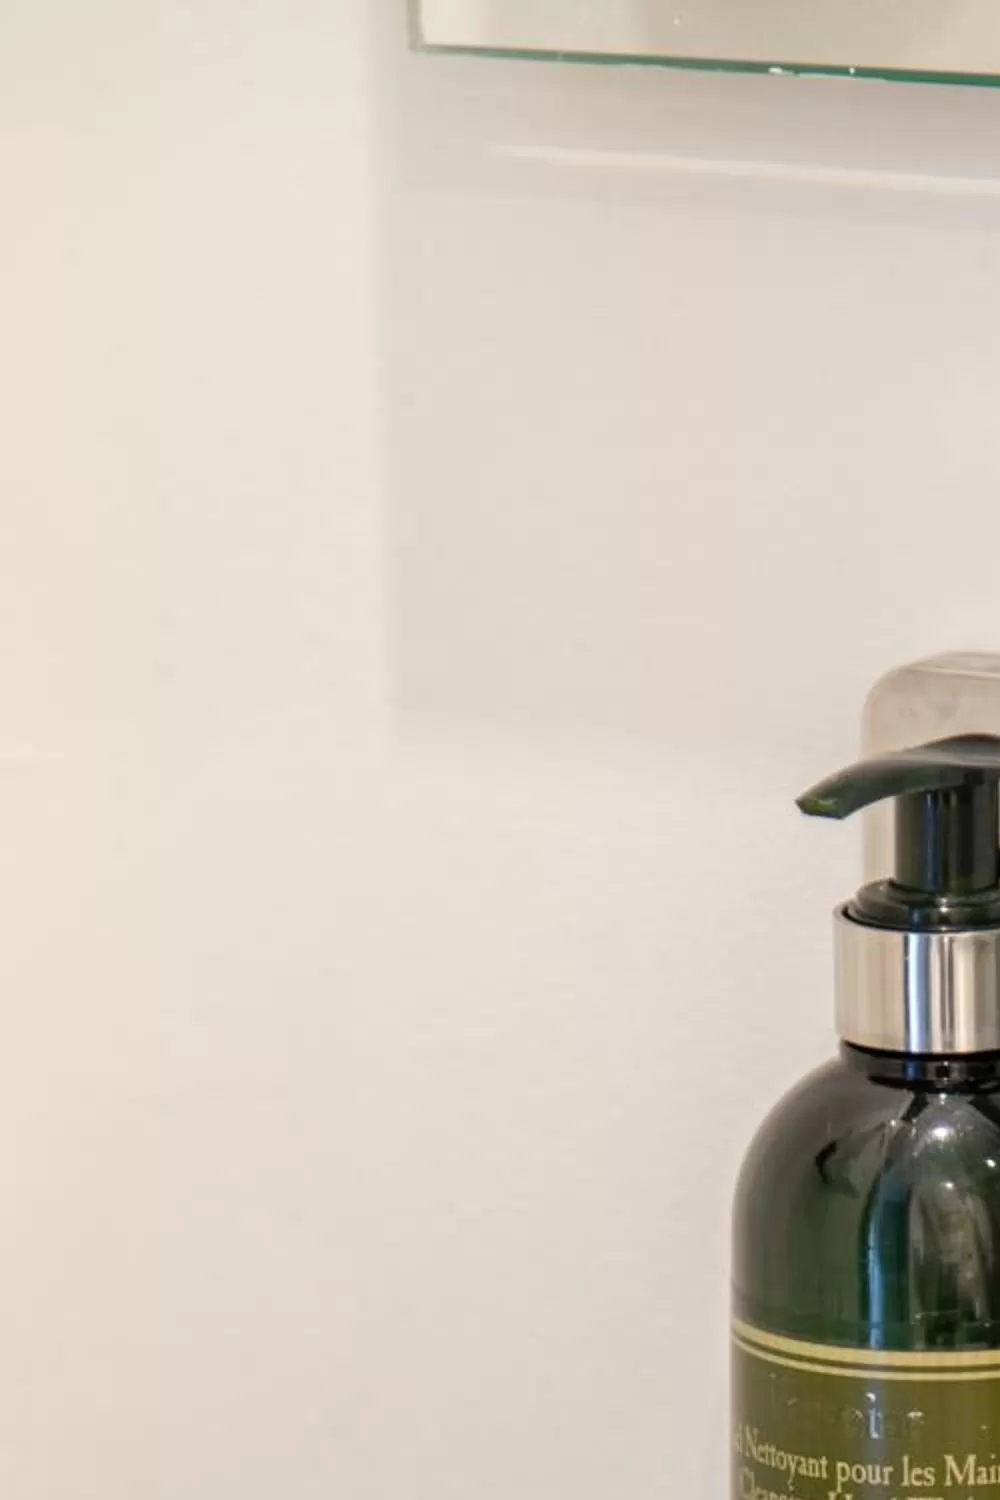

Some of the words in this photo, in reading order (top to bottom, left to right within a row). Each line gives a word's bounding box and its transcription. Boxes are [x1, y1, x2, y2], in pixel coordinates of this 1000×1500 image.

[744, 1423, 828, 1491] Nettoyant
[836, 1460, 893, 1493] pour
[901, 1454, 936, 1488] les
